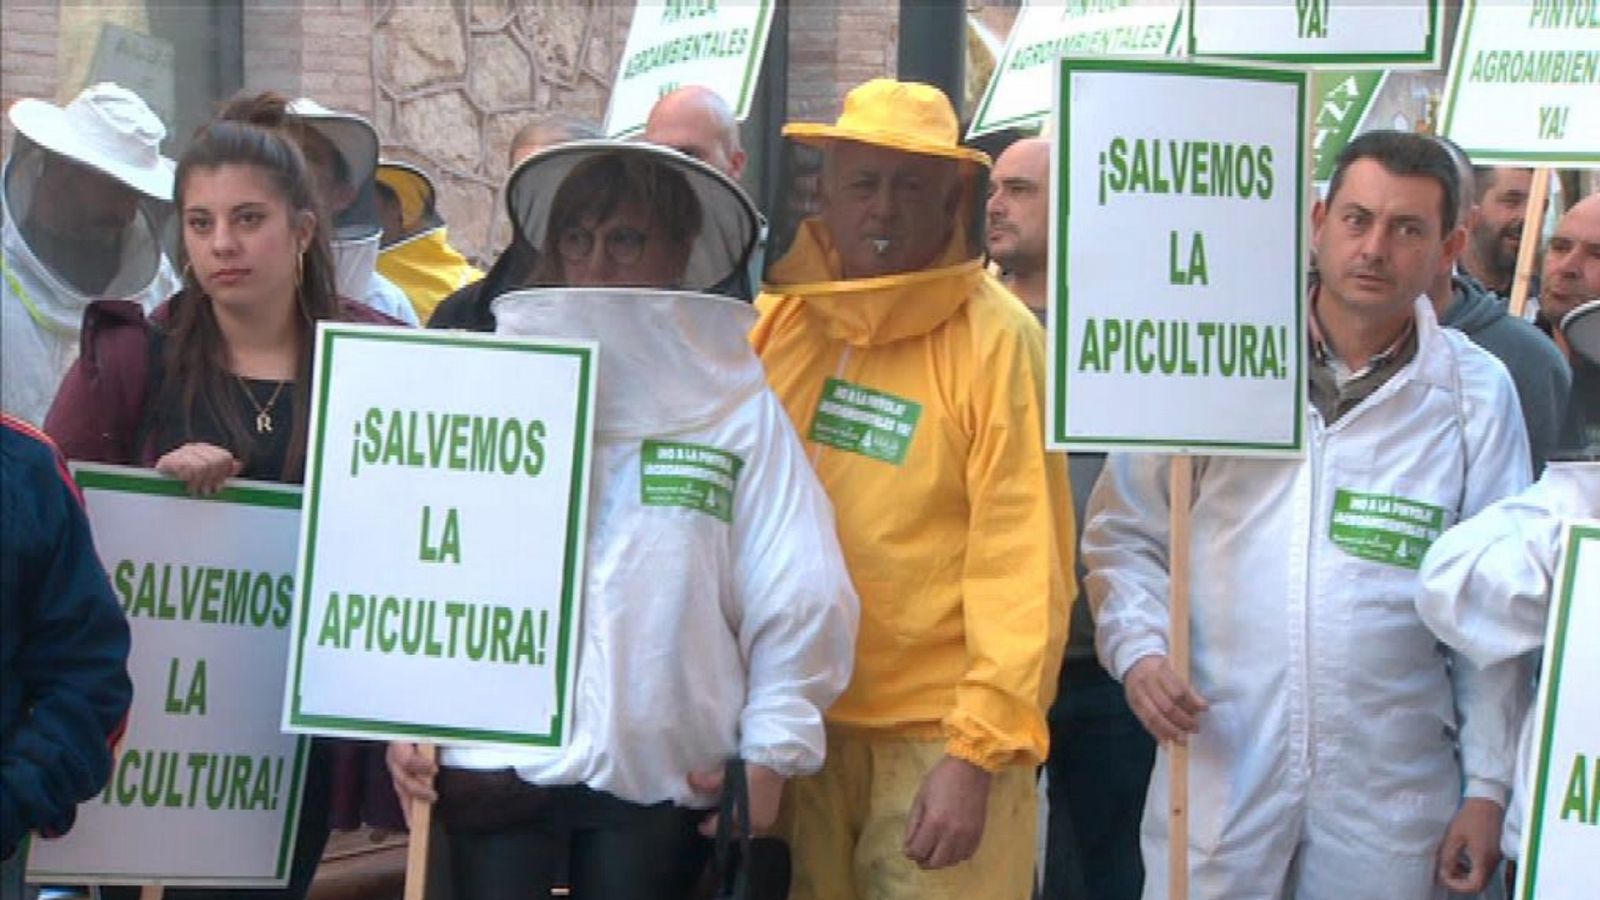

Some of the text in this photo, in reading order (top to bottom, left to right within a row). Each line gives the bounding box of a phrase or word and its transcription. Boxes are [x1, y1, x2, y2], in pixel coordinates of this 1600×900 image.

[1296, 0, 1328, 38] YA!
[1470, 49, 1600, 83] AGROAMBIEN
[1538, 106, 1569, 139] YA!
[1098, 136, 1273, 206] ¡SALVEMOS
[1170, 230, 1208, 285] LA
[1078, 318, 1287, 379] APICULTURA!
[351, 407, 546, 478] ¡SALVEMOS
[419, 505, 460, 564] LA
[317, 591, 548, 665] APICULTURA!
[164, 658, 206, 715] LA
[103, 749, 284, 810] CULTURA!
